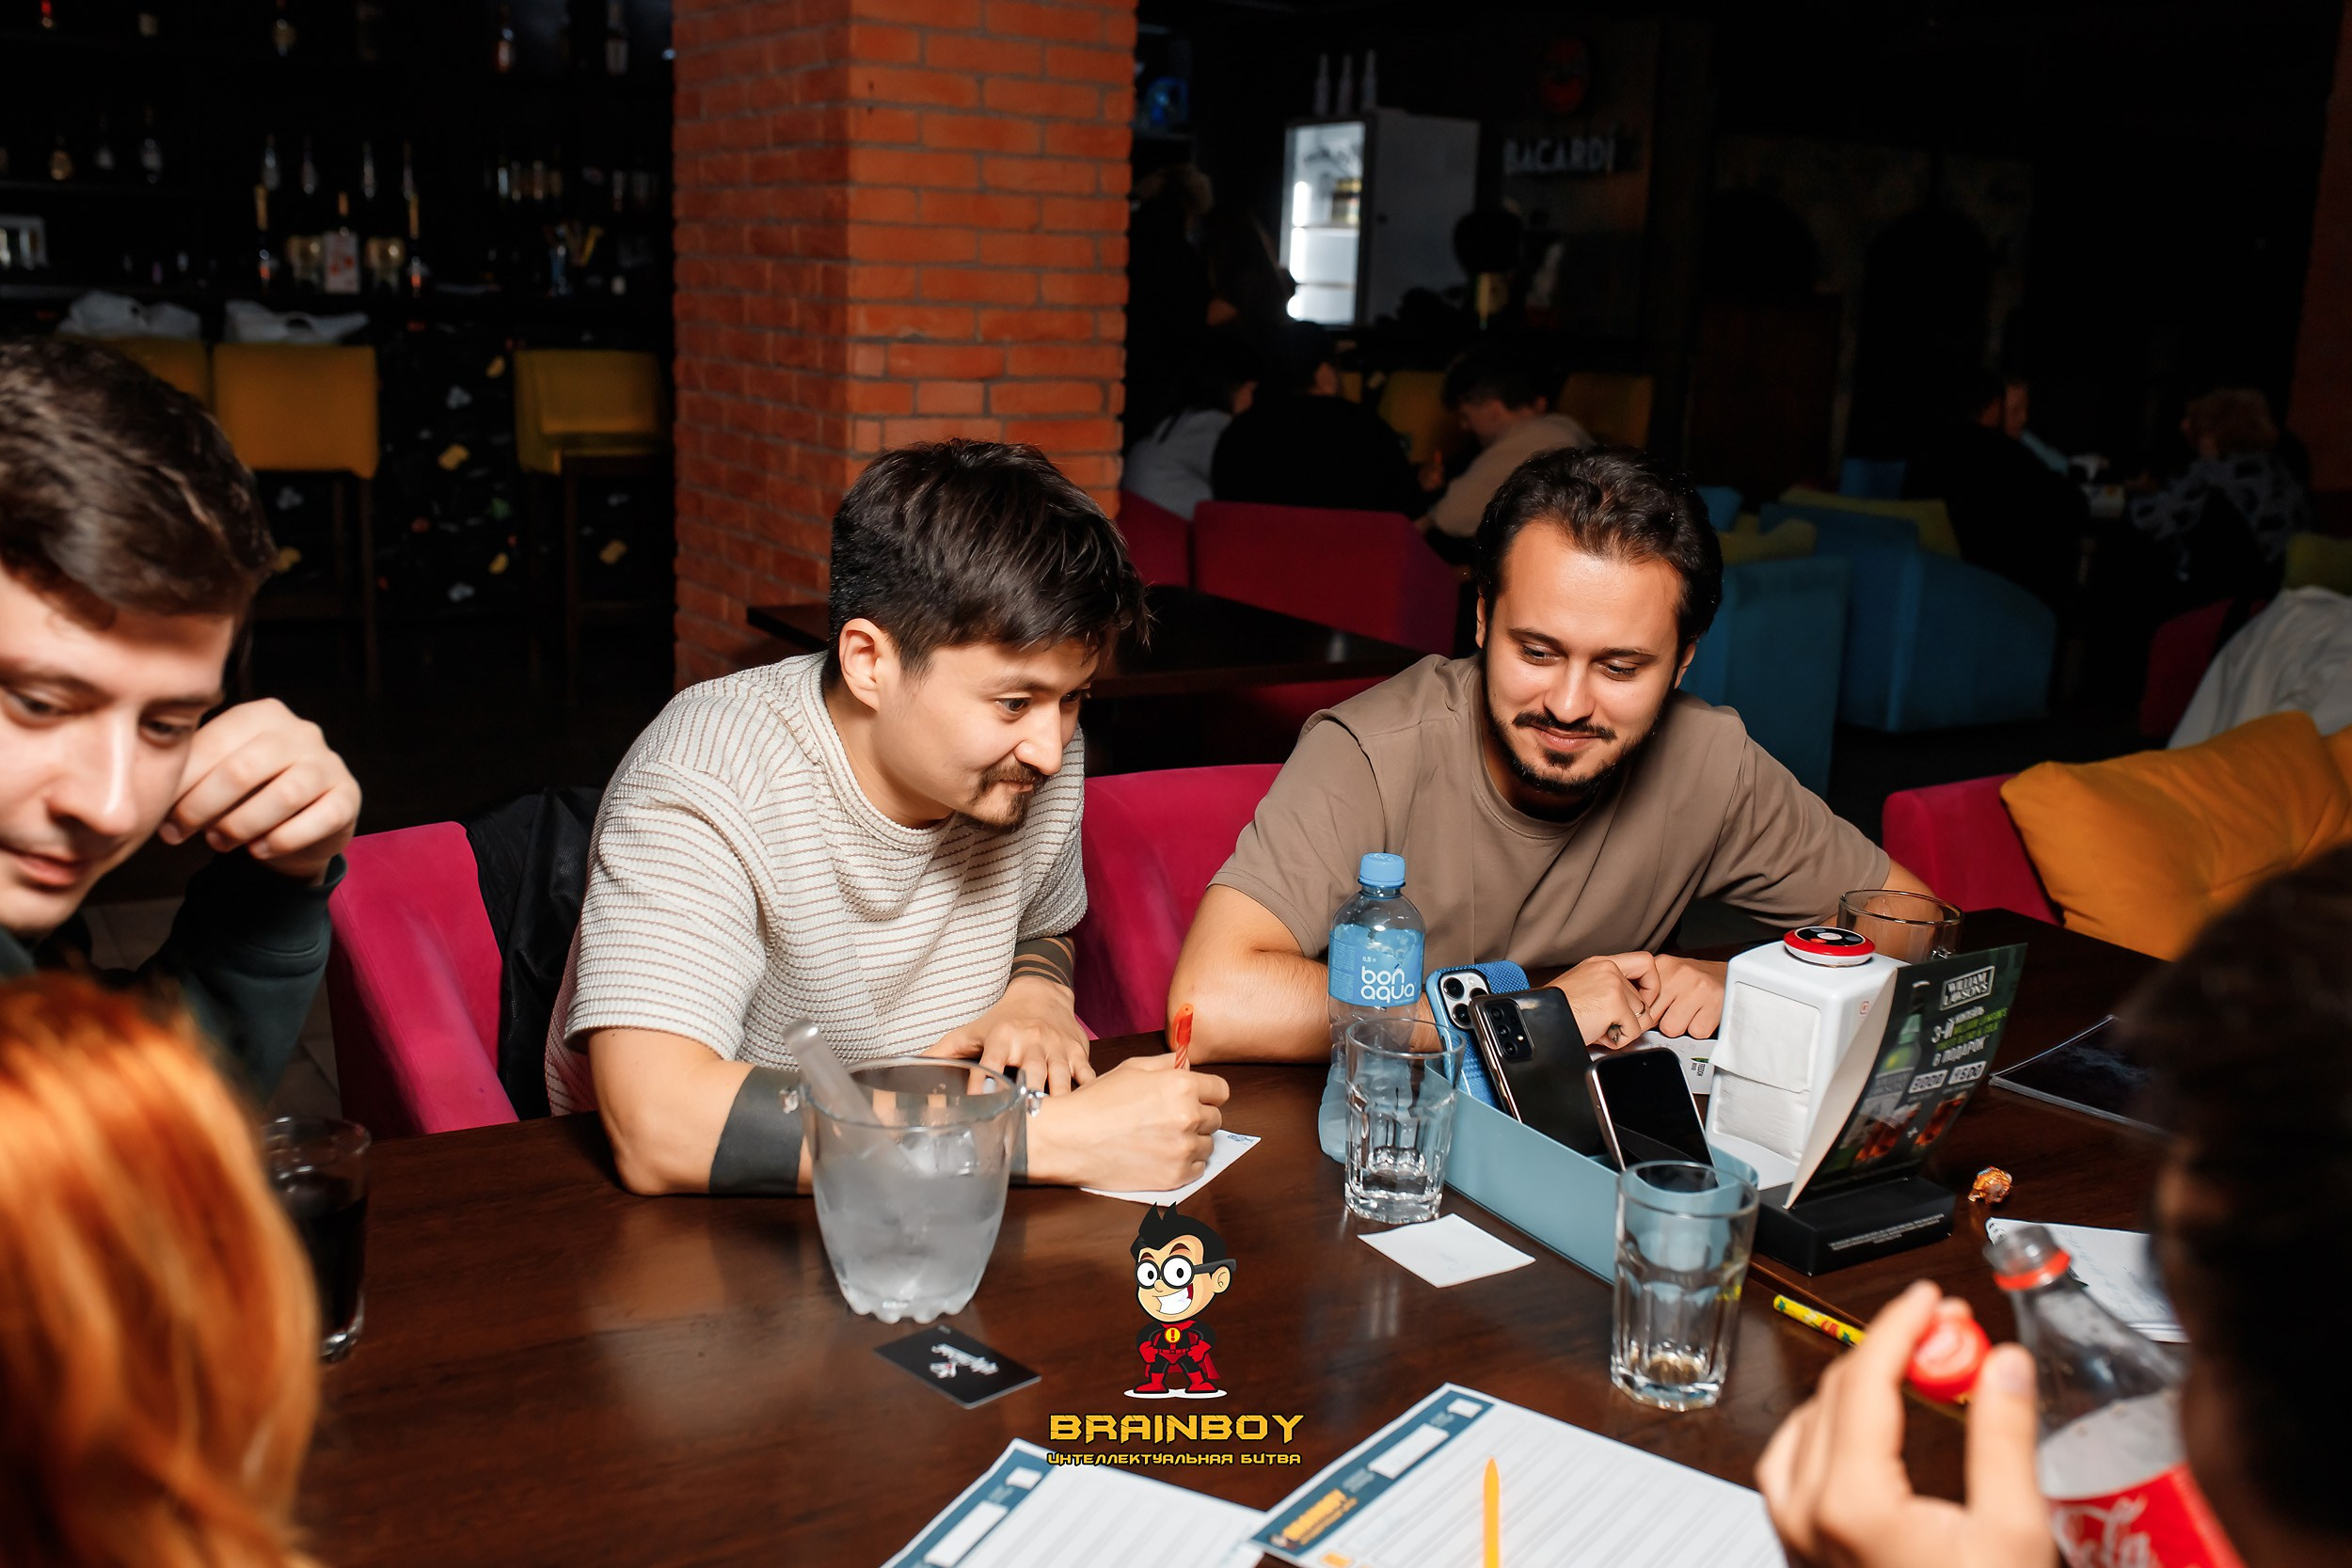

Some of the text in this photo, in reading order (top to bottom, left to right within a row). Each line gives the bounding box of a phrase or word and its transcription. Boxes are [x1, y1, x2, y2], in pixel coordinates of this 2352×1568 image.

[1361, 965, 1406, 986] bon
[1947, 972, 1988, 993] WILLIAM
[1360, 983, 1415, 1004] aqua
